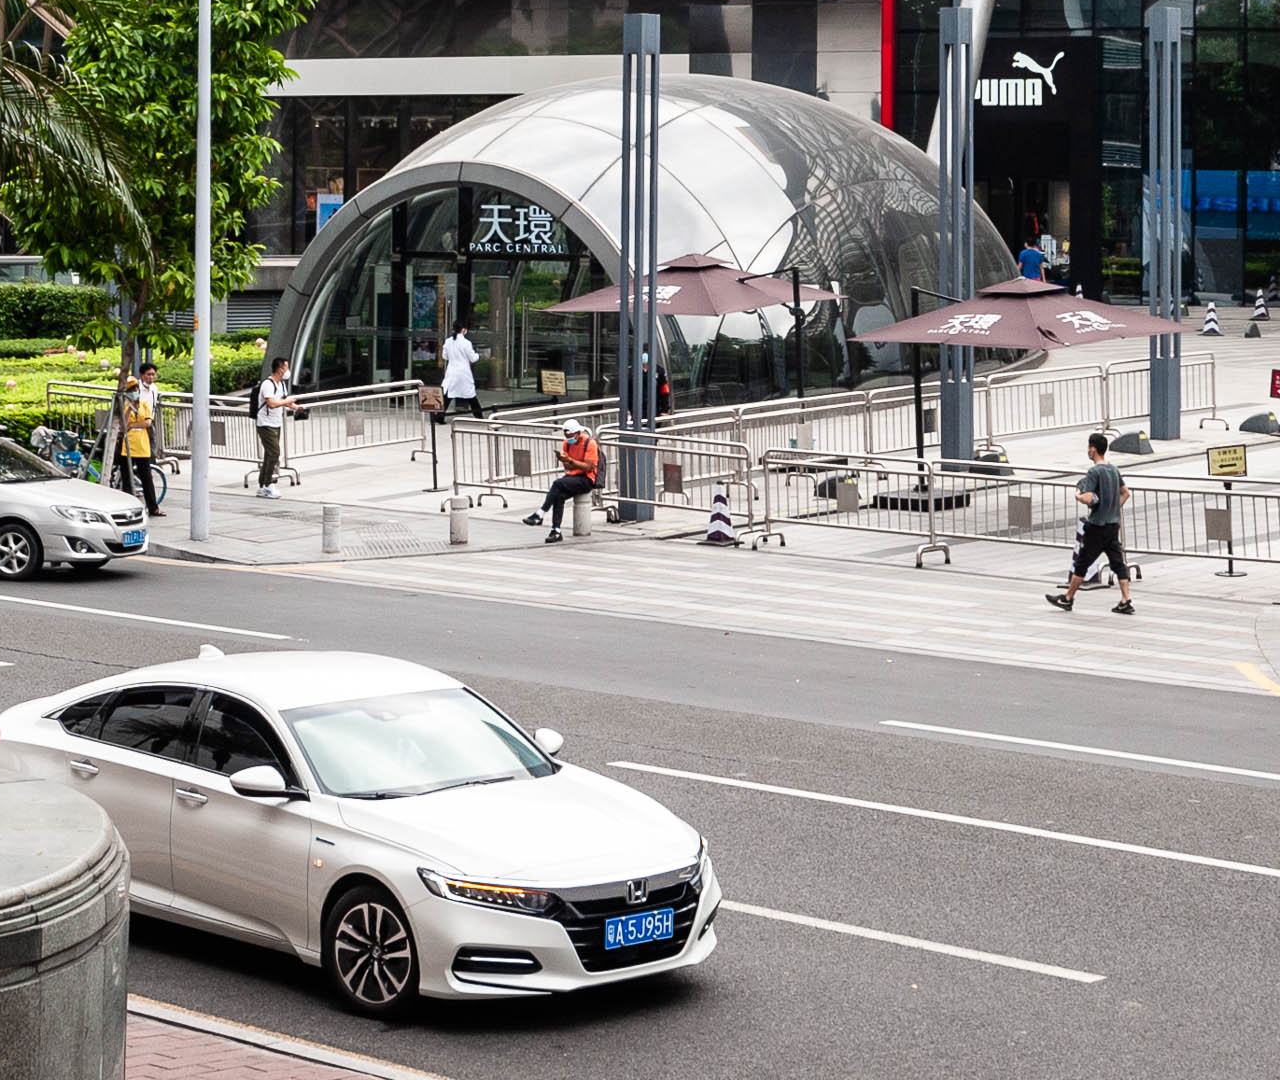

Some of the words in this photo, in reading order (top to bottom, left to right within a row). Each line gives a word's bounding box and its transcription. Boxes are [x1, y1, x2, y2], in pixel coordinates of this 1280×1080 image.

[479, 205, 553, 244] 天環
[469, 242, 501, 253] PARC
[506, 243, 564, 254] CENTRAL
[607, 913, 673, 945] 粤A·5J95H
